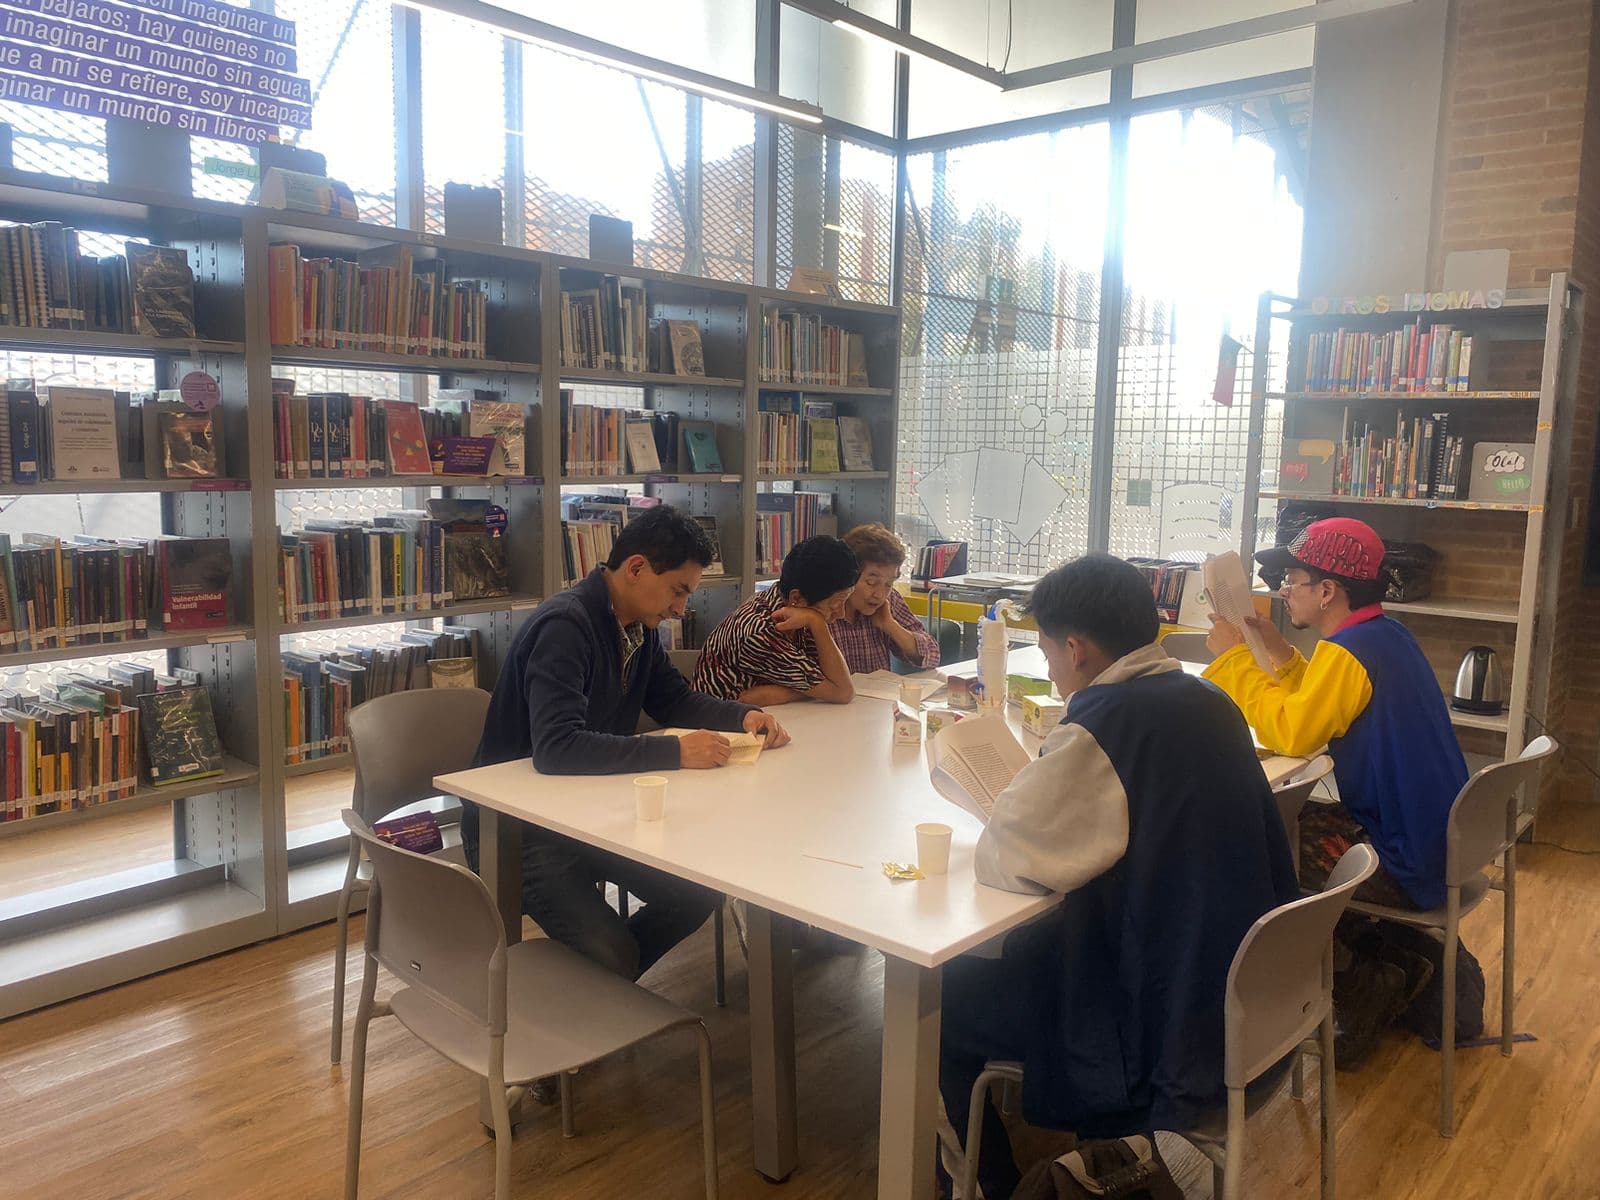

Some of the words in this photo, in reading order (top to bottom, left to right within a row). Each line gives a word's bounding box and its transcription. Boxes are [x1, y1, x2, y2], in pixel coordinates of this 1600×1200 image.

[138, 13, 176, 42] hay
[182, 28, 258, 60] quienes
[264, 48, 287, 66] no
[181, 0, 267, 33] imaginar
[273, 23, 294, 41] un
[6, 12, 109, 52] imaginar
[115, 41, 141, 61] un
[149, 49, 218, 78] mundo
[224, 65, 252, 86] sin
[258, 74, 308, 100] agua;
[29, 53, 43, 70] a
[51, 57, 81, 77] mí
[87, 65, 113, 84] se
[120, 71, 192, 104] refiere,
[200, 89, 234, 112] soy
[239, 94, 310, 125] incapaz
[63, 90, 90, 110] un
[98, 97, 171, 125] mundo
[178, 112, 208, 132] sin
[1404, 288, 1506, 312] IDIOMAS
